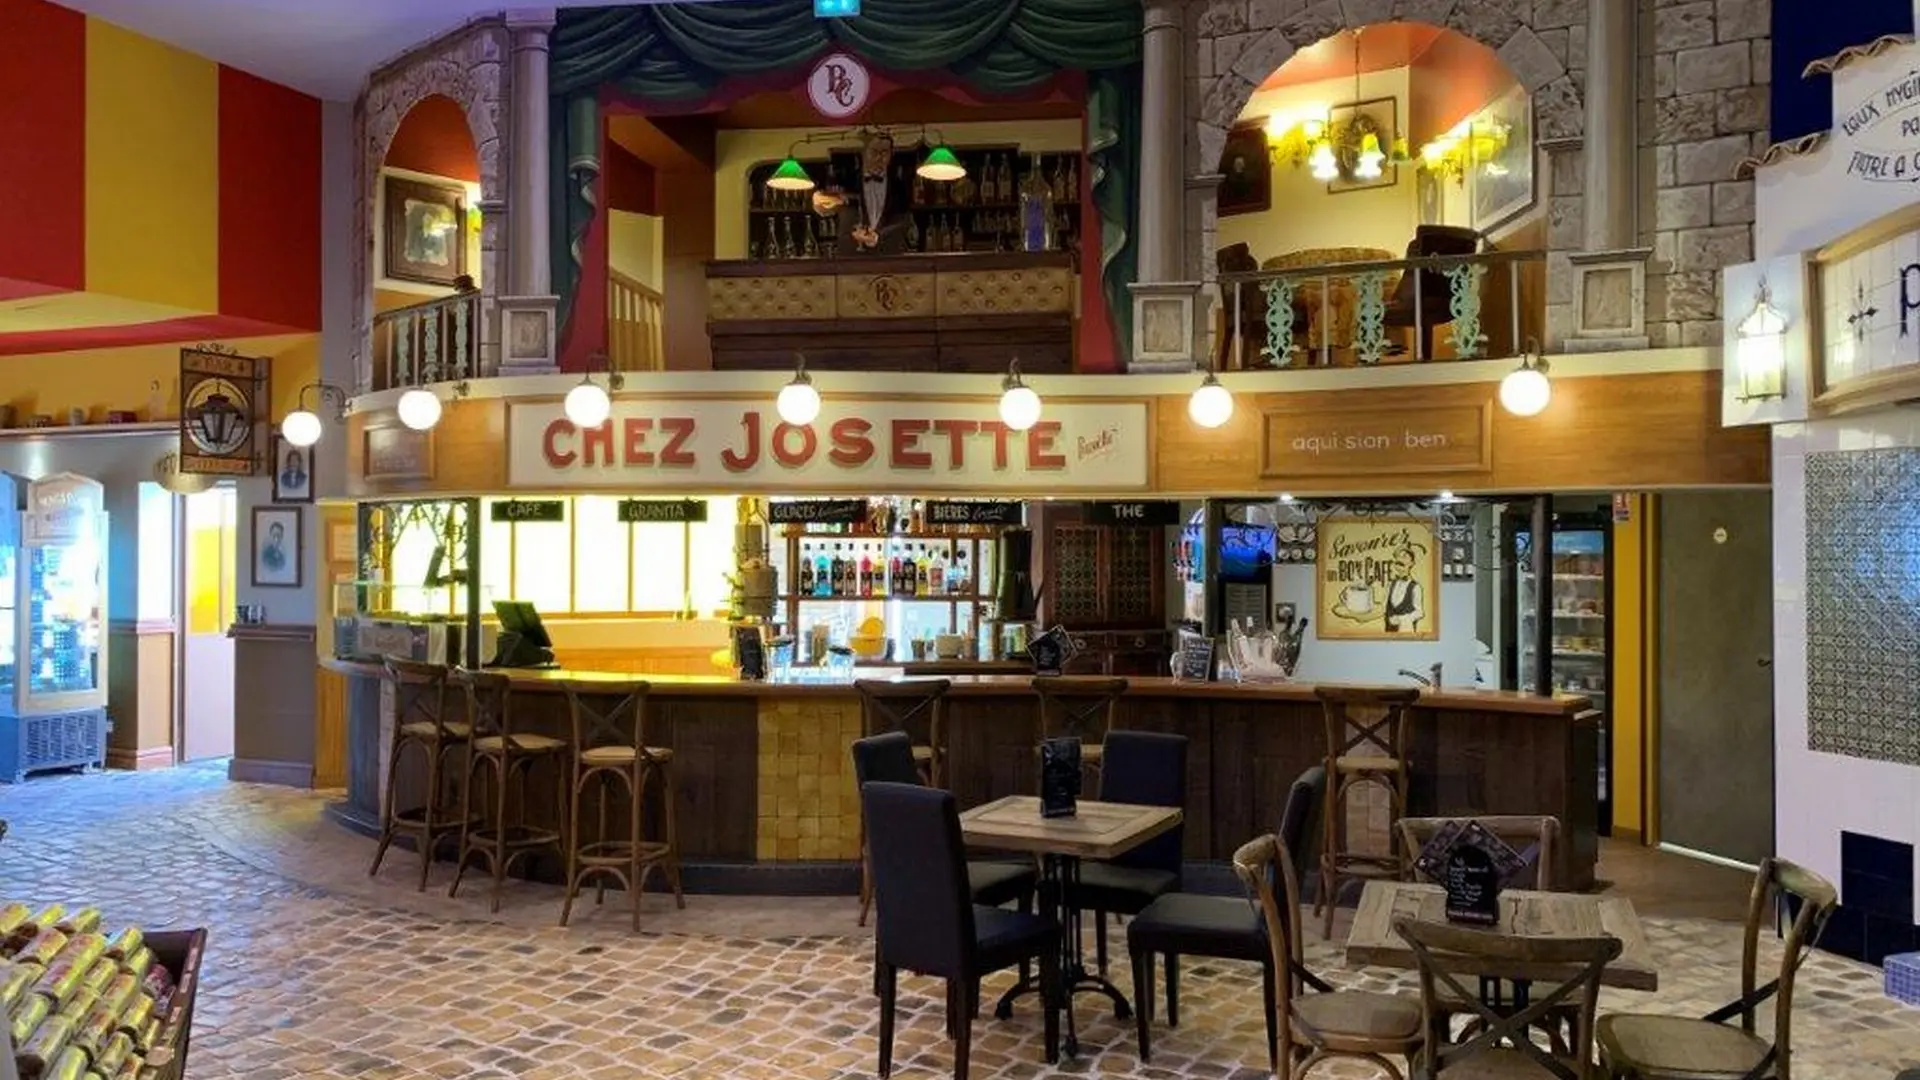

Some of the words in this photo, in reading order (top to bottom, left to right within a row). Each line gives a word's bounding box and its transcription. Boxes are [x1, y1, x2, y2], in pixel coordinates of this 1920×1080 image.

[542, 416, 697, 469] CHEZ
[720, 411, 1067, 473] JOSETTE
[1292, 432, 1338, 456] aqui
[1404, 428, 1447, 449] ben
